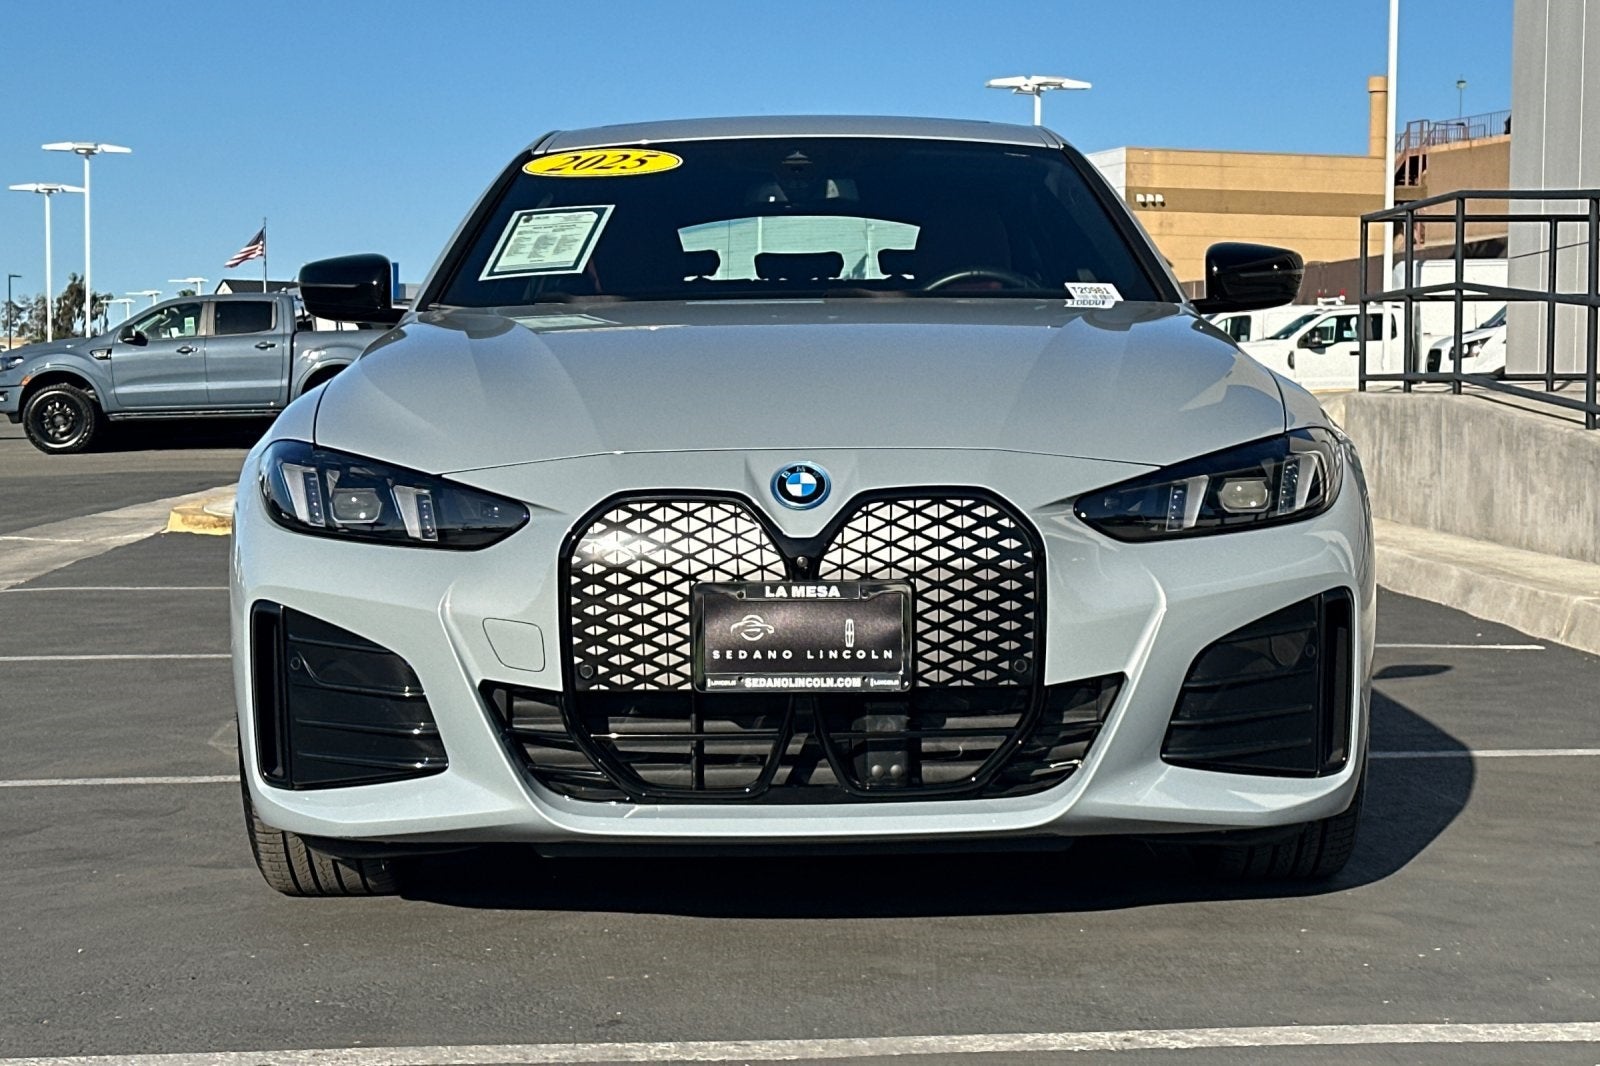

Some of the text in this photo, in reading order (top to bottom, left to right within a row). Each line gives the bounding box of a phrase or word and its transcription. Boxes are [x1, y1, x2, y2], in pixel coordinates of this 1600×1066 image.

[545, 154, 660, 172] 2025
[764, 585, 841, 598] LA MESA
[712, 649, 893, 660] SEDANO LINCOLN
[744, 677, 861, 688] SEDANOLINCOLN.COM
